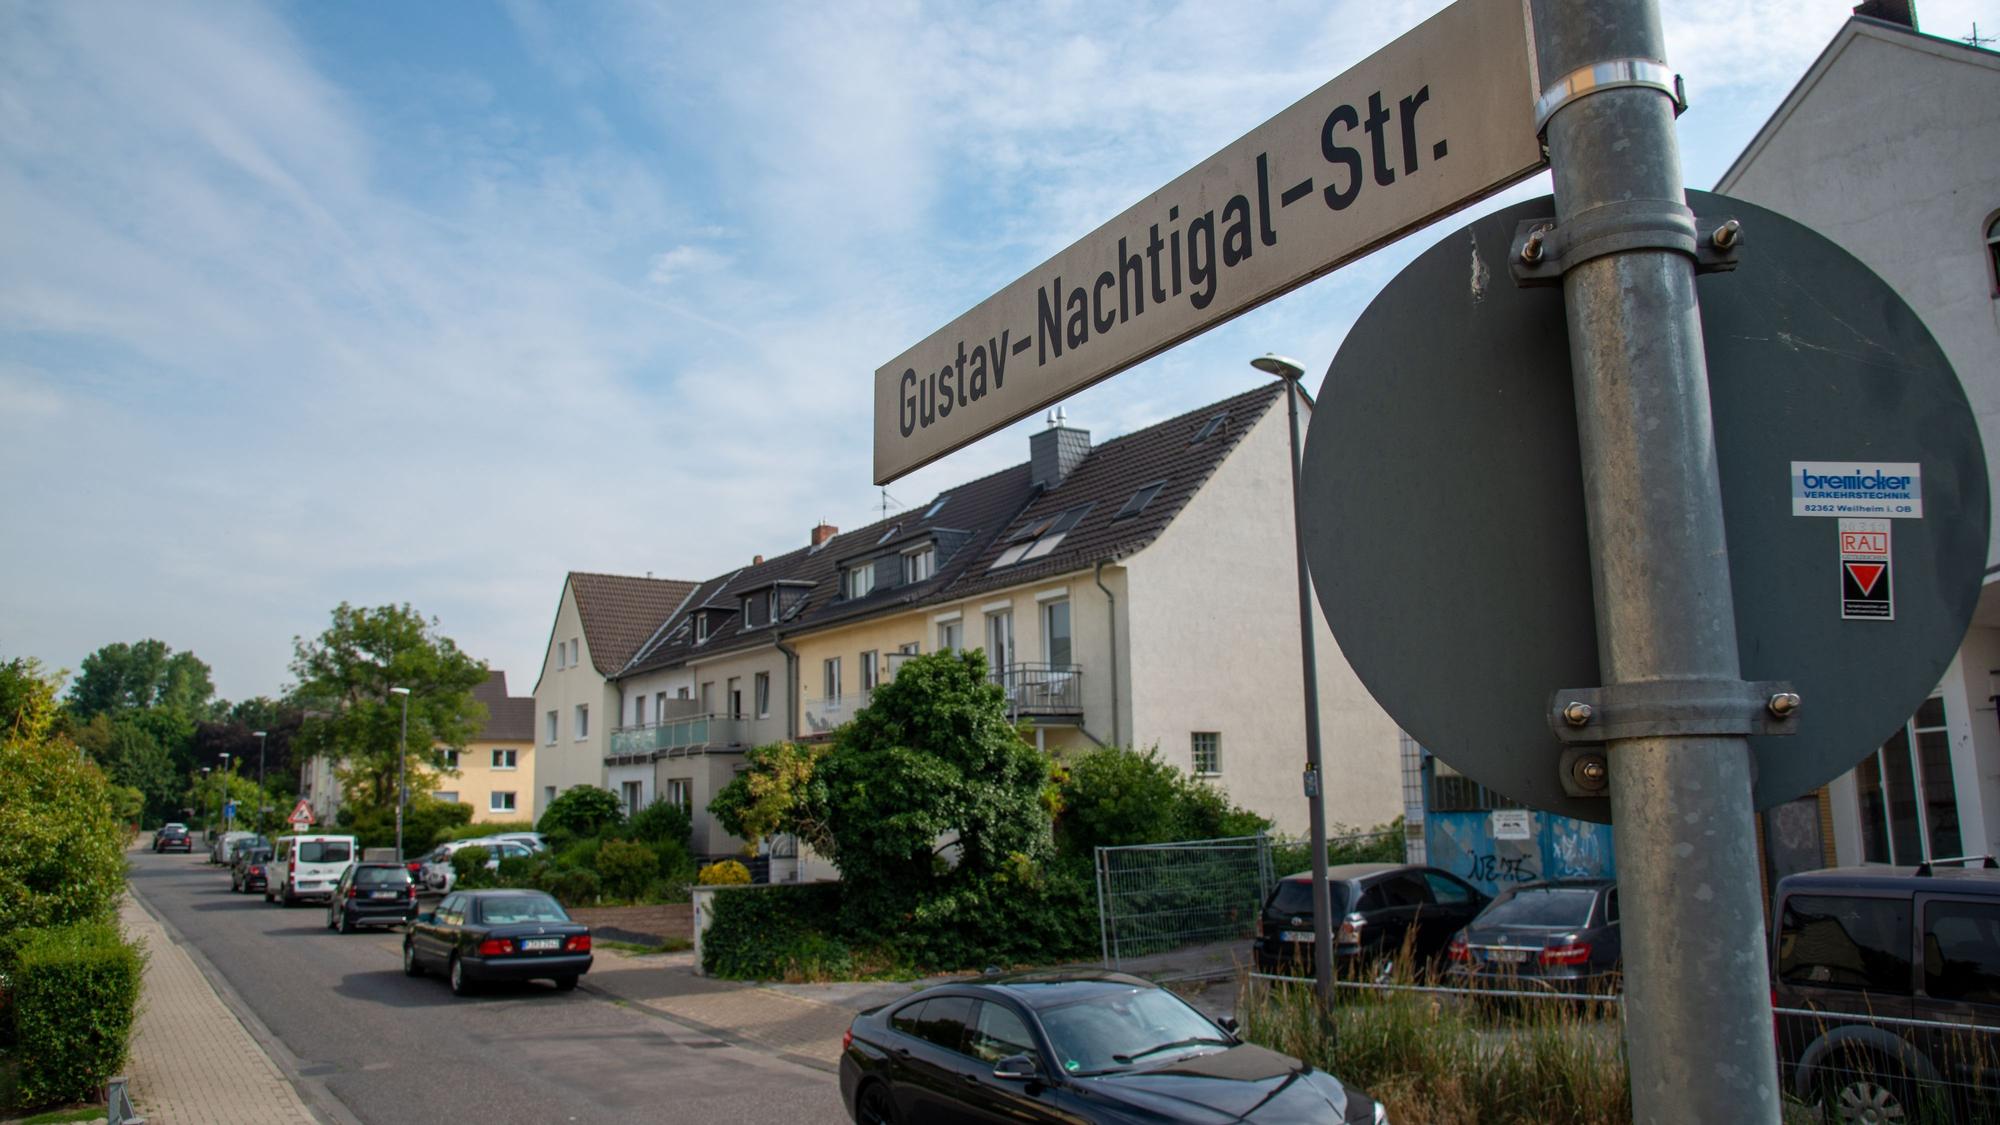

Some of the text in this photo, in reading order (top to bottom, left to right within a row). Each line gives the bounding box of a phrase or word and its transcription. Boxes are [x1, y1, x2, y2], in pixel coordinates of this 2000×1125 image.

[898, 84, 1449, 439] Gustav-Nachtigal-Str.
[1802, 469, 1911, 490] bremicker
[1804, 491, 1911, 500] VERKEHRSTECHNIK
[1804, 504, 1834, 513] 82362
[1837, 505, 1885, 513] Weilheim
[1844, 535, 1884, 551] RAL
